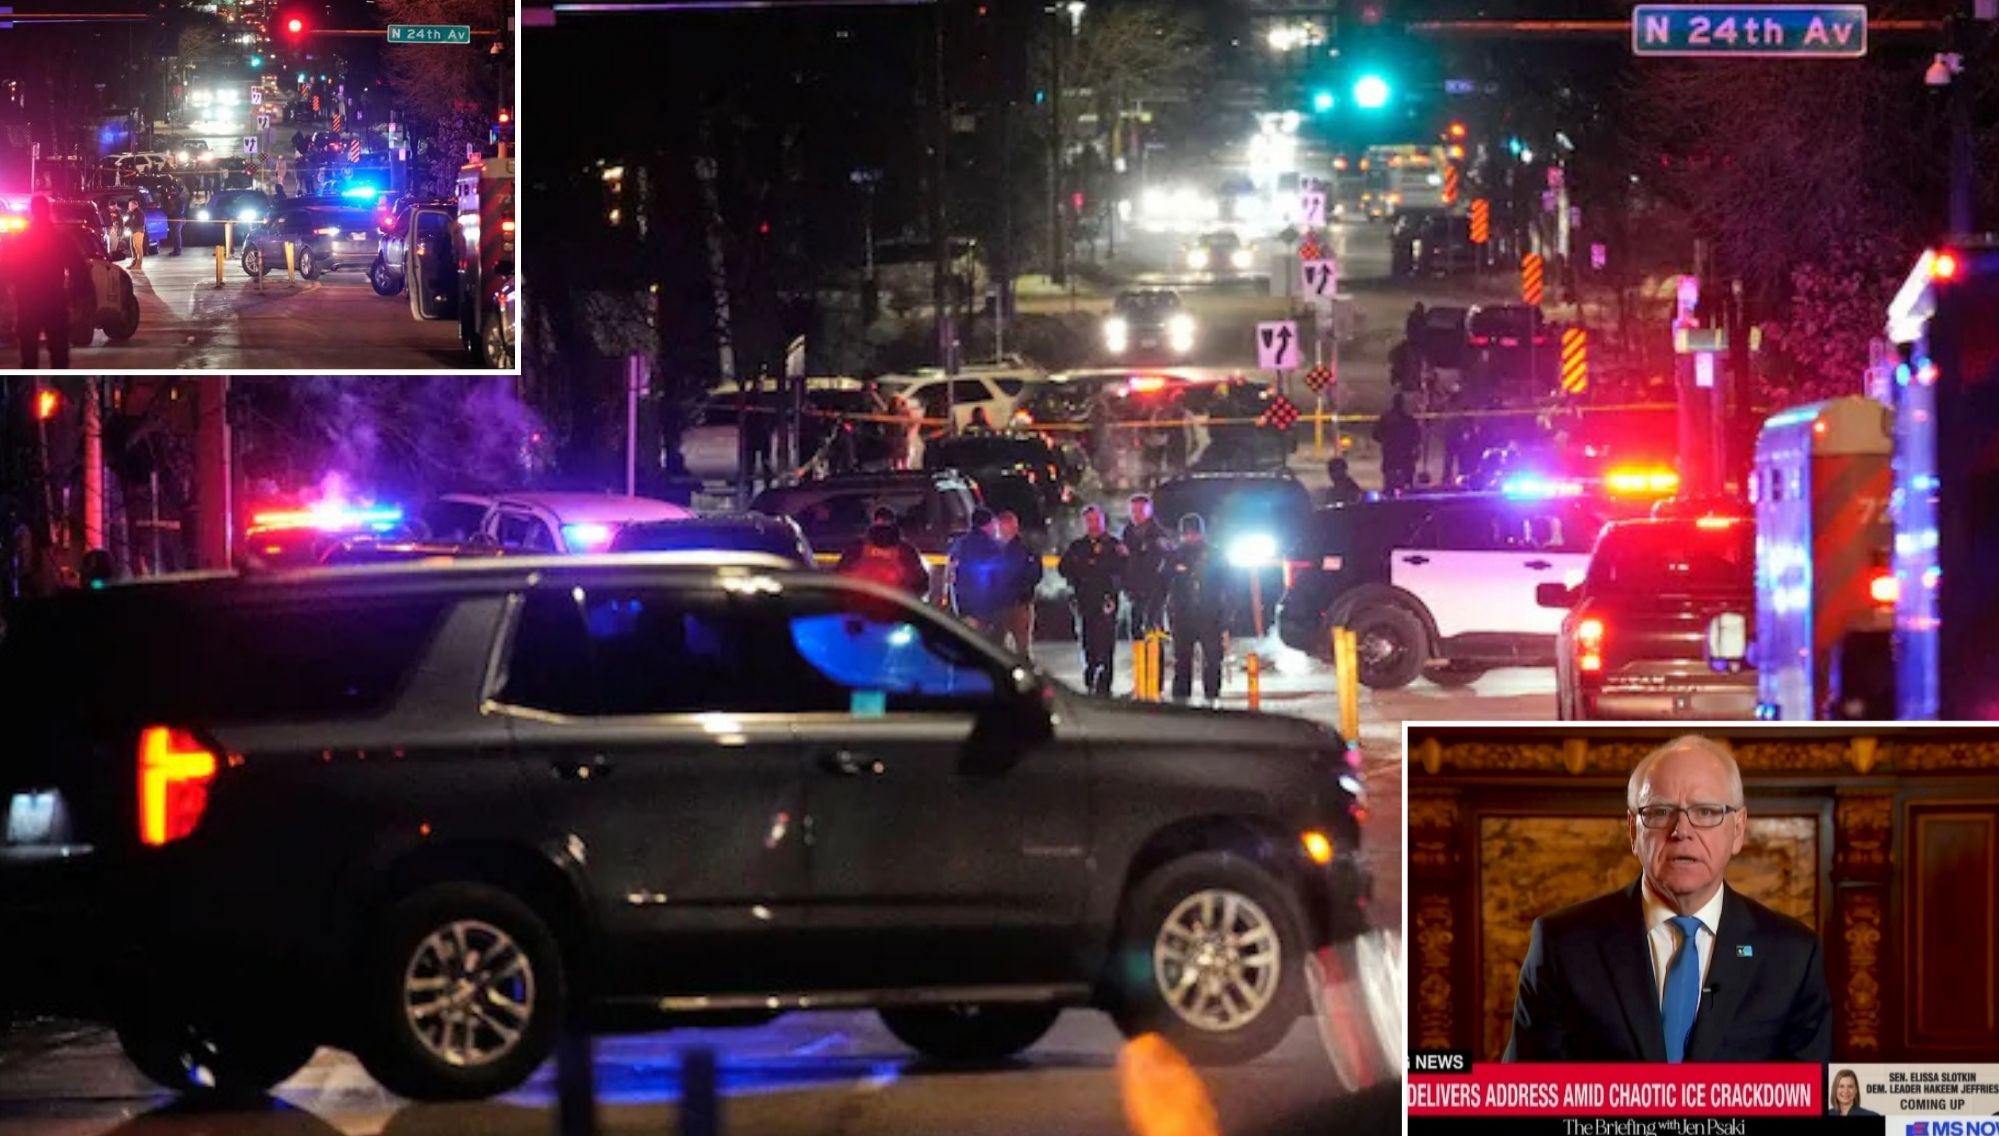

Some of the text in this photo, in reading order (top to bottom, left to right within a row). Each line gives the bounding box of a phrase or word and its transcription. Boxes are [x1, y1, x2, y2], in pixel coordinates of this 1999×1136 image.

[391, 28, 465, 40] N 24th Av
[1645, 15, 1852, 44] N 24th Av
